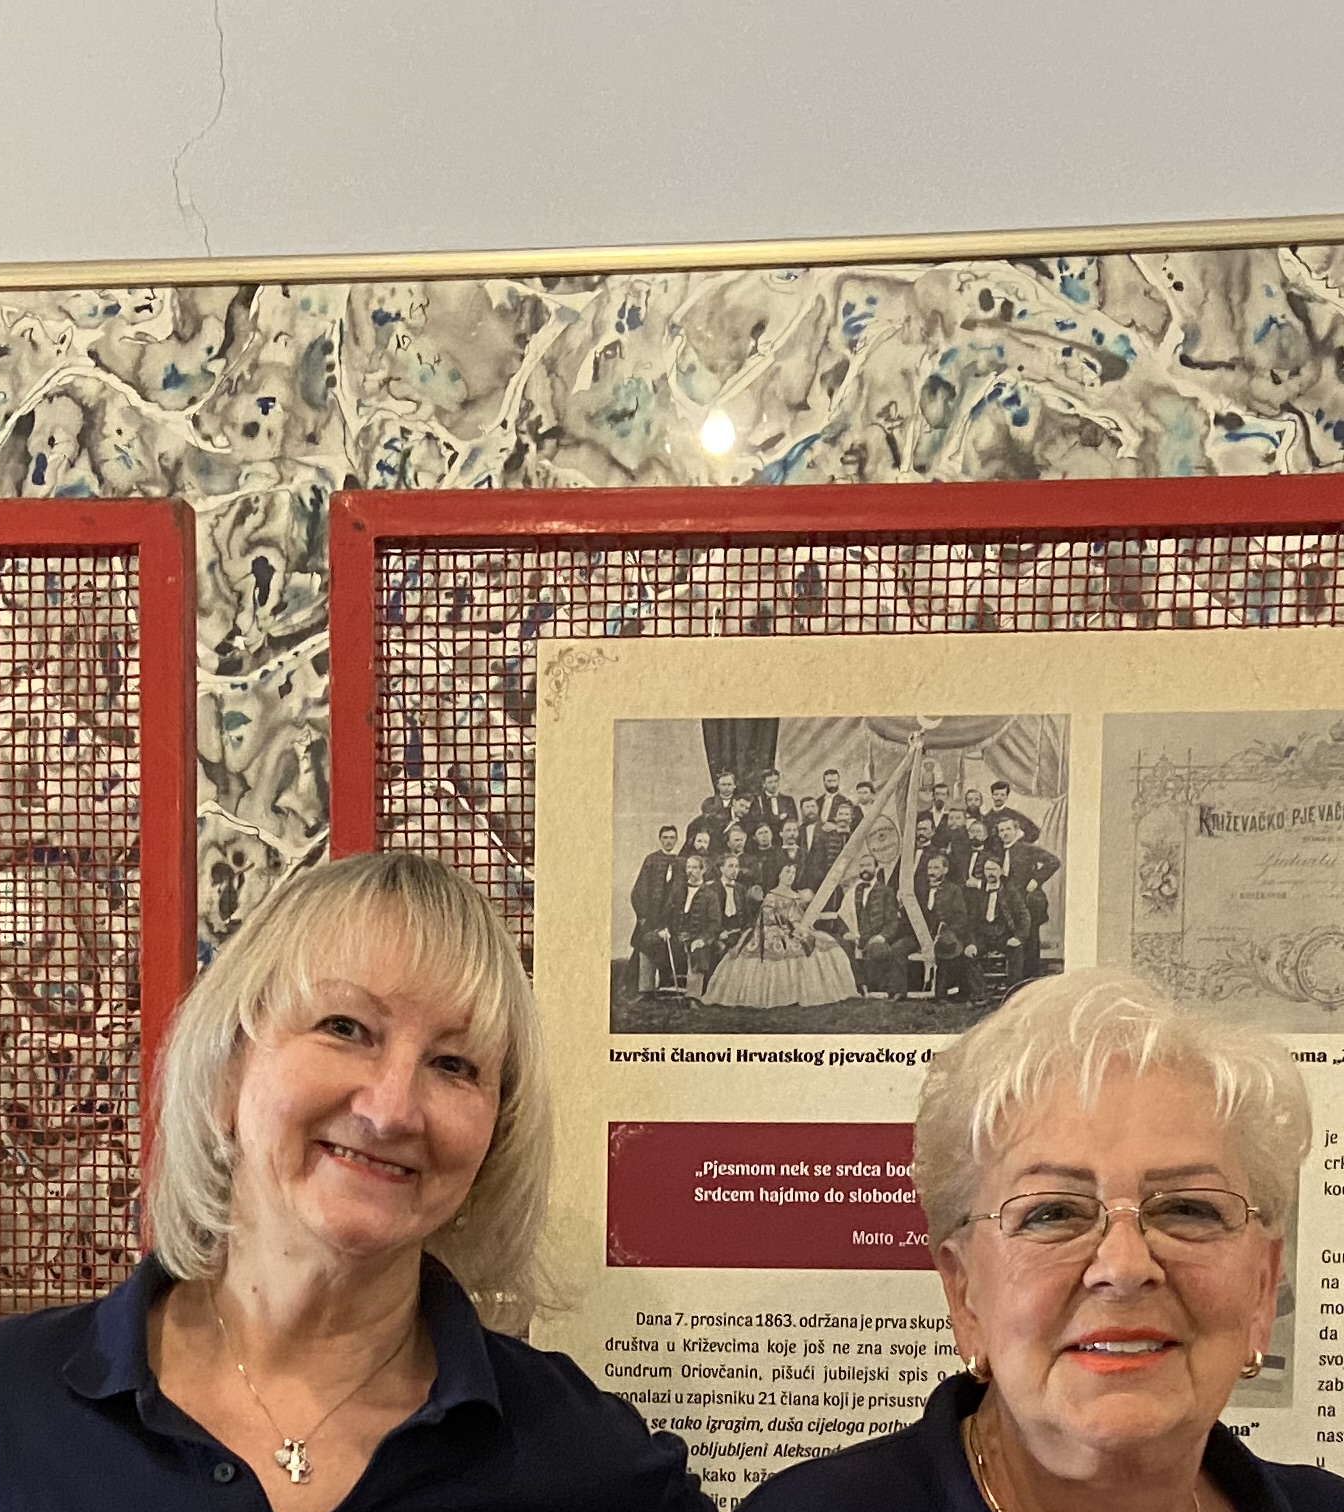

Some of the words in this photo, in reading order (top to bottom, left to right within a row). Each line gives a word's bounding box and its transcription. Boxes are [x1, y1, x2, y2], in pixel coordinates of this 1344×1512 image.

[610, 1046, 666, 1062] Izvršni
[671, 1046, 732, 1062] članovi
[737, 1048, 826, 1066] Hrvatskog
[829, 1047, 918, 1066] pjevačkog
[1324, 1129, 1338, 1147] je
[781, 1160, 810, 1176] nek
[814, 1164, 832, 1176] se
[836, 1160, 882, 1176] srdca
[695, 1185, 755, 1202] Srdcem
[760, 1186, 820, 1206] hajdmo
[824, 1187, 845, 1203] do
[853, 1230, 894, 1245] Motto
[637, 1311, 672, 1325] Dana
[675, 1312, 689, 1326] 7.
[691, 1311, 754, 1330] prosinca
[756, 1312, 797, 1327] 1863.
[800, 1314, 857, 1330] održana
[859, 1314, 873, 1331] je
[875, 1318, 907, 1333] prva
[605, 1335, 659, 1352] društva
[667, 1341, 676, 1352] u
[683, 1337, 760, 1353] Križevcima
[768, 1338, 797, 1358] koje
[803, 1338, 826, 1358] još
[833, 1342, 851, 1354] ne
[857, 1342, 883, 1355] zna
[890, 1340, 927, 1359] svoje
[605, 1362, 673, 1378] Gundrum
[681, 1362, 763, 1381] Oriovčanin,
[772, 1363, 815, 1382] pišući
[824, 1365, 890, 1384] jubilejski
[899, 1366, 929, 1385] spis
